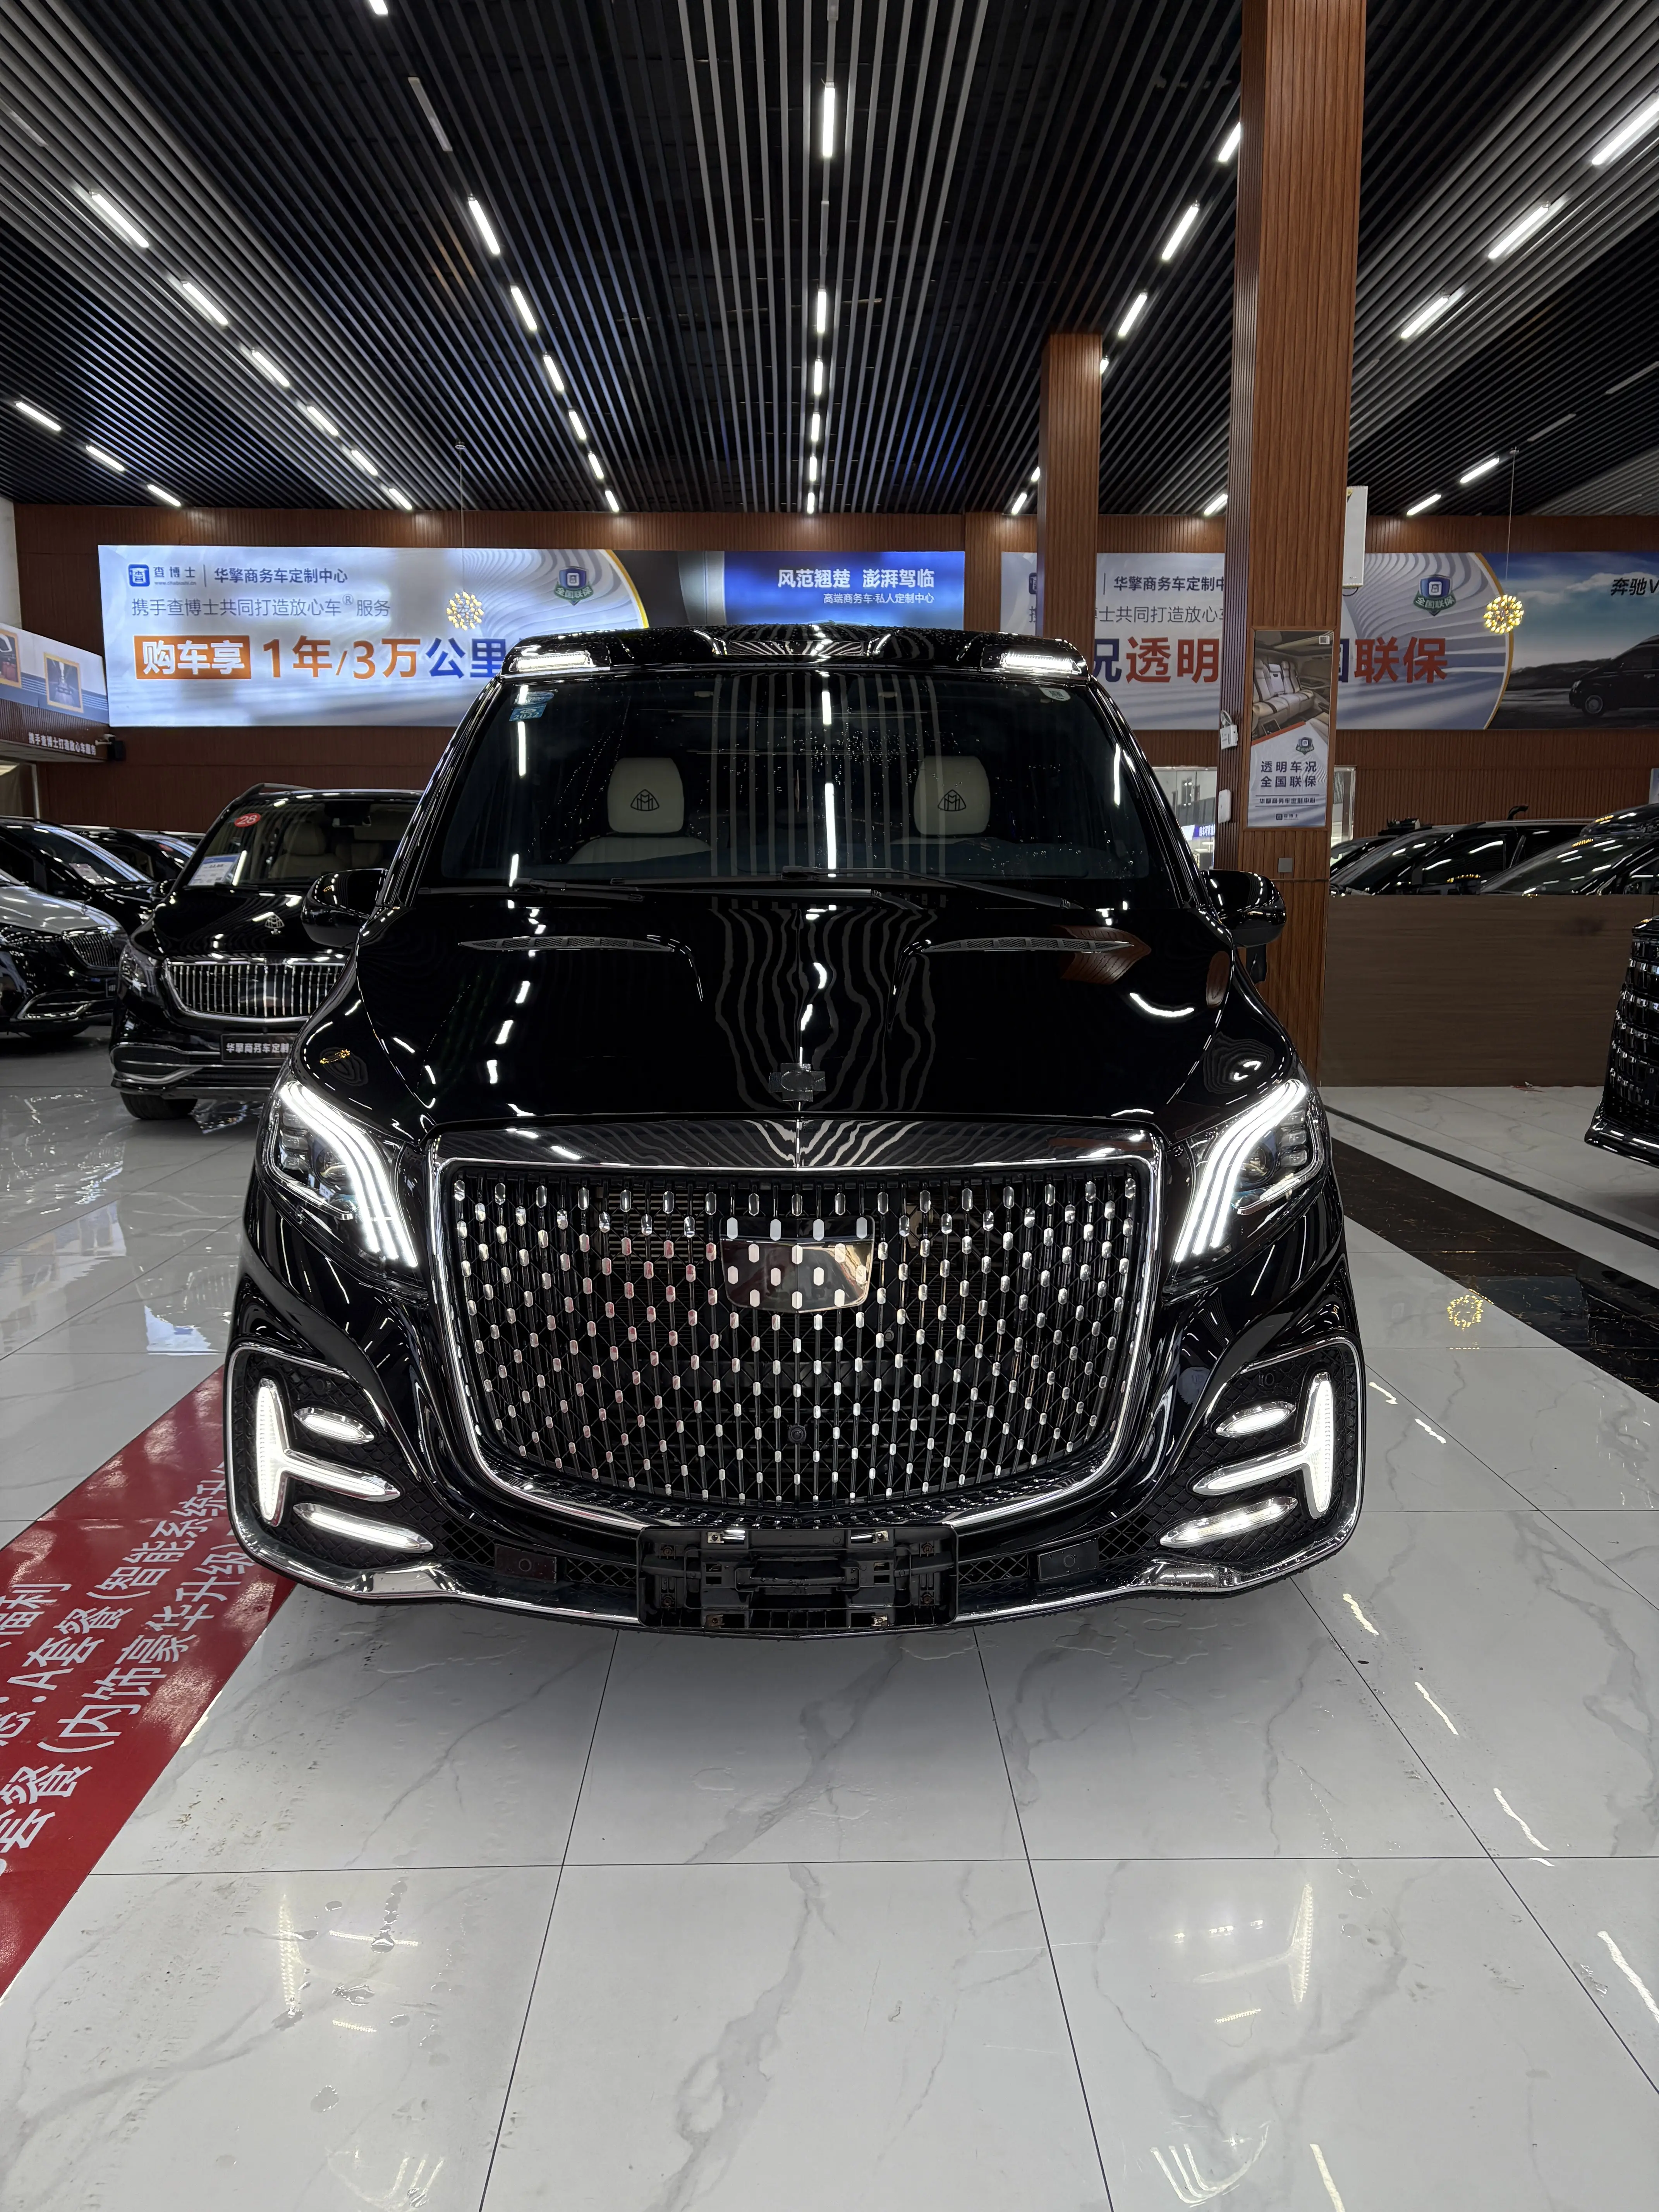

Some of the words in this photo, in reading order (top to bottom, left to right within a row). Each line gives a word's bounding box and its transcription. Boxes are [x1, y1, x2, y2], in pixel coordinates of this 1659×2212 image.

[154, 567, 196, 578] 查博士
[214, 567, 348, 583] 华擎商务车定制中心
[778, 568, 851, 588] 风范翘楚
[862, 568, 935, 588] 澎湃驾临
[556, 586, 592, 599] 全国联保
[1415, 596, 1455, 609] 全国联保
[1095, 606, 1223, 623] 士共同打造放心
[142, 640, 245, 675] 购车享
[263, 635, 522, 680] 1年/3万公里
[1339, 636, 1448, 684] 联保
[1261, 761, 1317, 773] 透明车况
[1261, 775, 1316, 788] 全国联保
[226, 1043, 292, 1053] 华擎商务车定制
[0, 1583, 72, 1648] 福利
